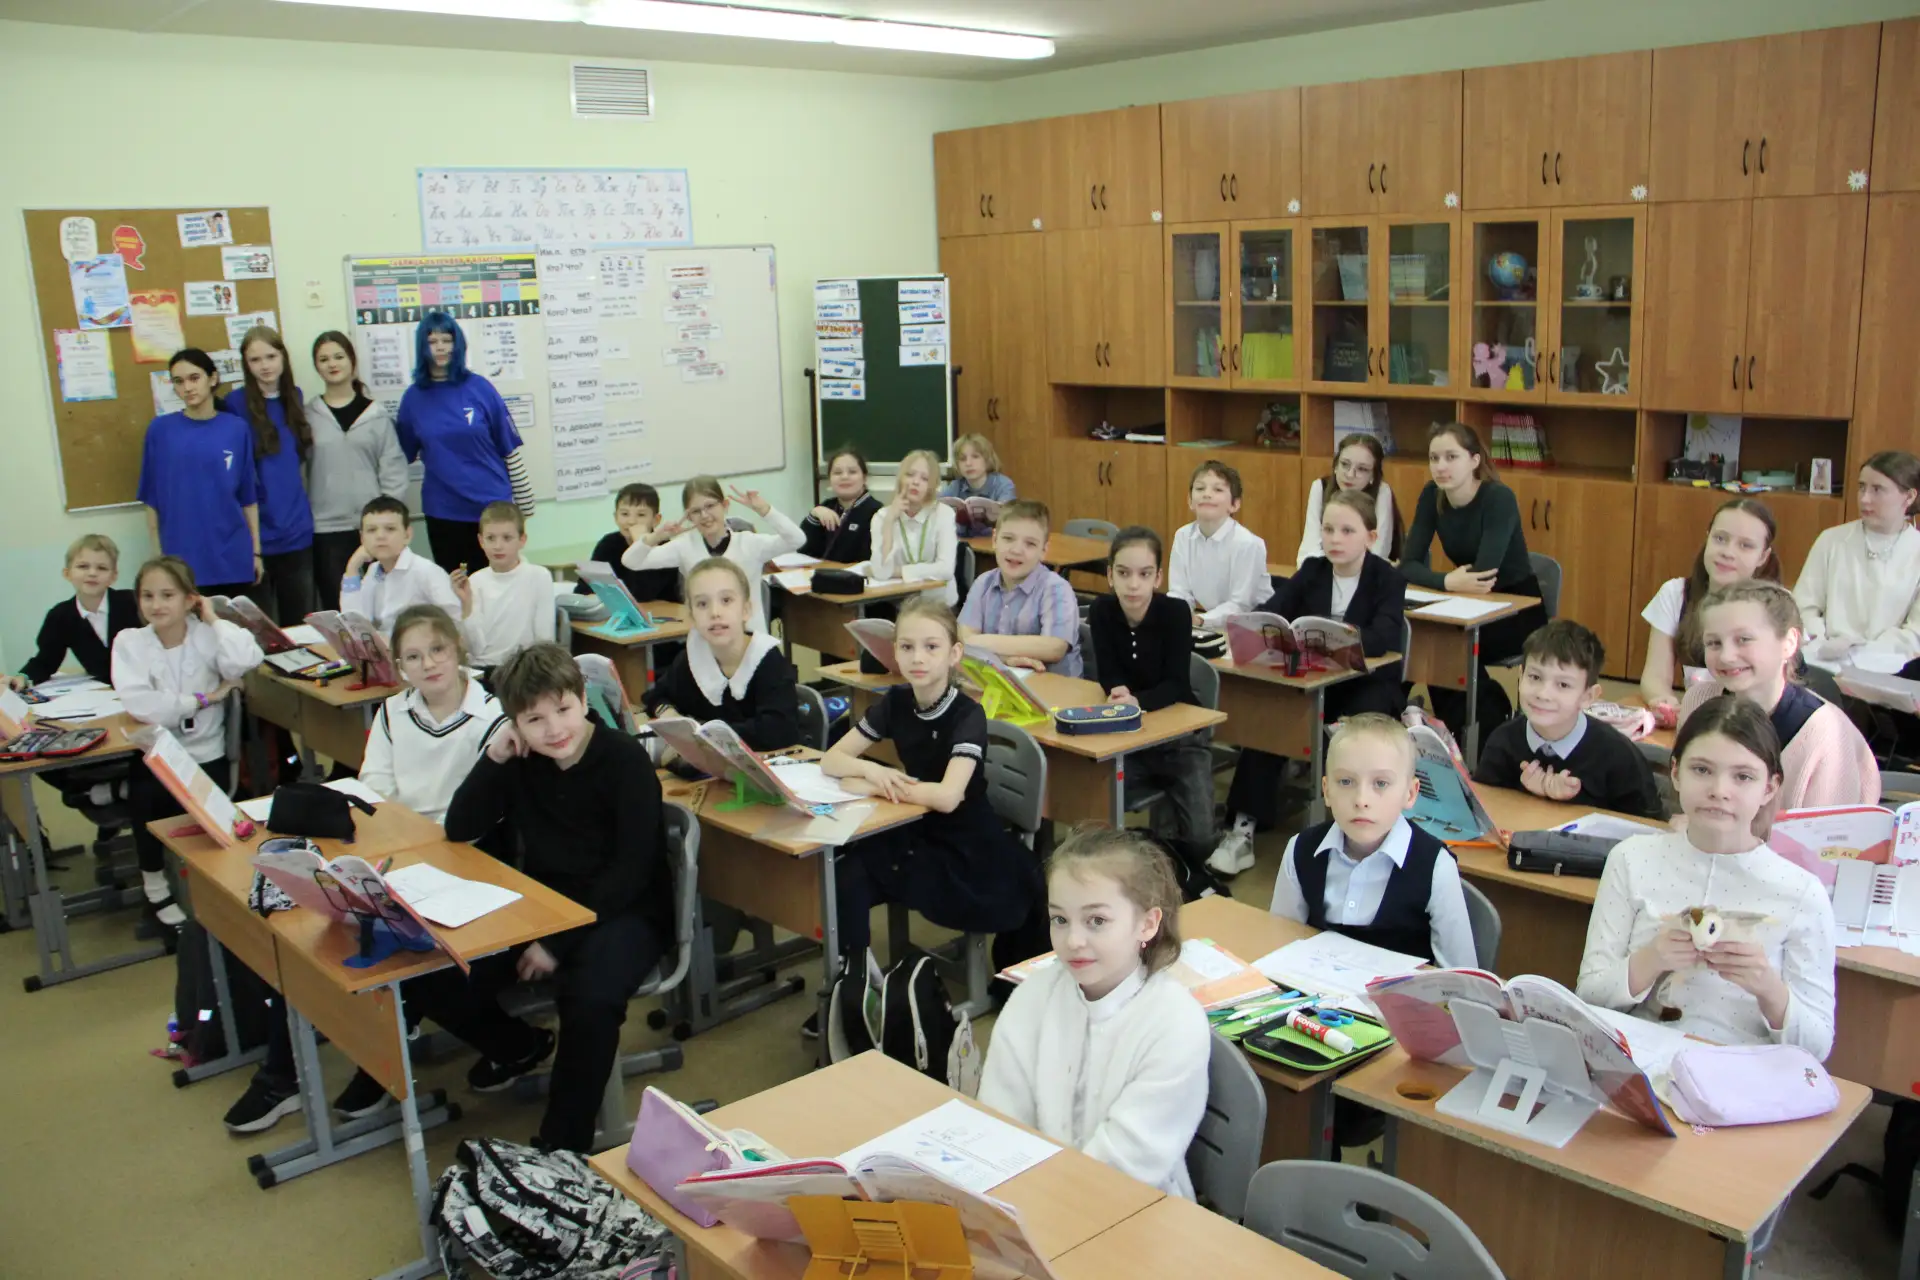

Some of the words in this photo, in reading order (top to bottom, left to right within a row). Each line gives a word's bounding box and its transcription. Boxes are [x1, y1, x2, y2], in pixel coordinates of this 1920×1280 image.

[364, 310, 372, 324] 9
[407, 308, 415, 322] 7
[468, 304, 477, 317] 4
[488, 304, 496, 316] 3
[507, 303, 516, 315] 2
[527, 302, 534, 314] 1
